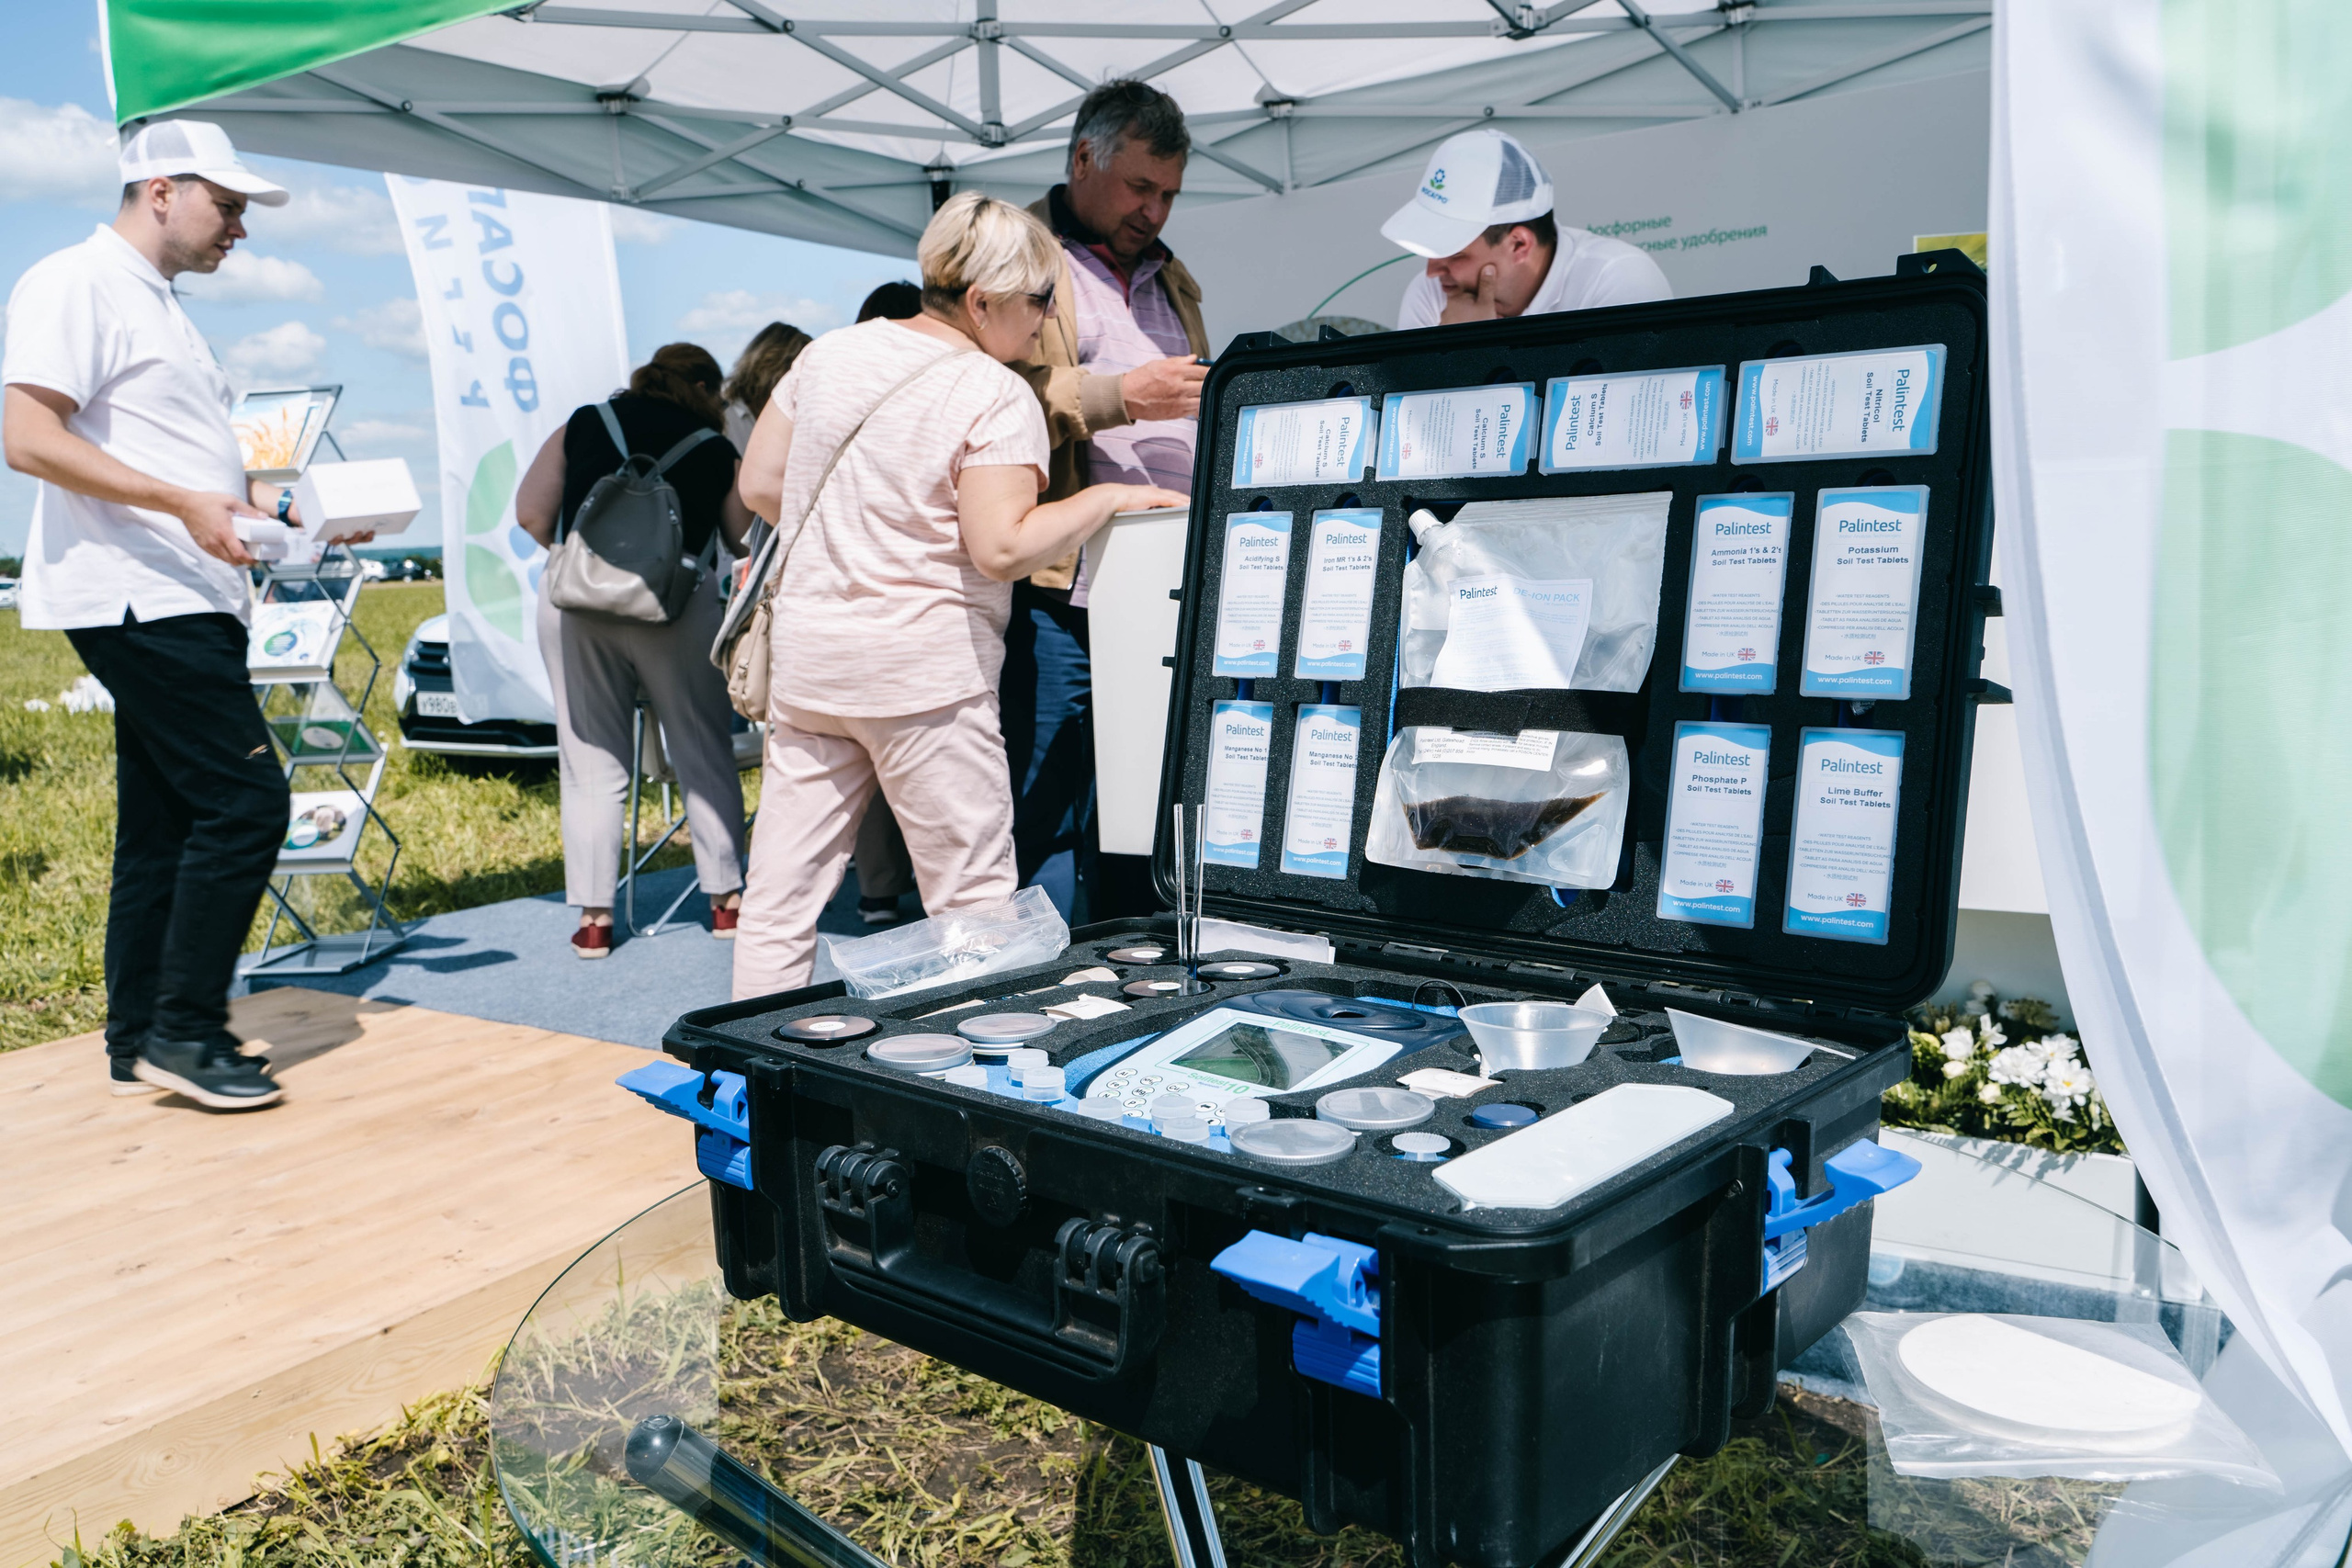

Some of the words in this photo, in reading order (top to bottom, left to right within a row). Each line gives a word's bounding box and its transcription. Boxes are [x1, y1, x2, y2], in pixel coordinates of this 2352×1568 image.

[1680, 225, 1768, 252] удобрения
[1865, 372, 1873, 388] Soil
[1599, 383, 1608, 409] Tablets
[1863, 391, 1871, 409] Test
[1892, 368, 1910, 432] Palintest
[1745, 375, 1758, 446] www.palintest.com
[1770, 404, 1776, 413] UK
[1872, 389, 1883, 422] Nitricol
[1565, 394, 1580, 450] Palintest
[1587, 401, 1597, 435] Calcium
[1681, 412, 1688, 421] UK
[1699, 380, 1713, 449] www.palintest.com
[1479, 417, 1488, 450] Calcium
[1496, 404, 1511, 457] Palintest
[1860, 412, 1870, 442] Tablets
[1322, 428, 1330, 459] Calcium
[1336, 416, 1350, 467] Palintest
[1386, 406, 1397, 468] www.palintest.com
[1240, 419, 1252, 476] www.palintest.com
[1470, 443, 1478, 468] Tablets
[1714, 521, 1772, 536] Palintest
[1838, 517, 1902, 533] Palintest
[1239, 536, 1278, 547] Palintest
[1326, 533, 1367, 544] Palintest
[1711, 547, 1747, 556] Ammonia
[1848, 546, 1898, 554] Potassium
[1460, 585, 1498, 600] Palintest
[1513, 587, 1551, 602] DE-ION
[1553, 593, 1580, 603] PACK
[1694, 671, 1762, 681] www.palintest.com
[1817, 676, 1892, 685] www.palintest.com
[1226, 723, 1264, 736] Palintest
[1310, 728, 1352, 741] Palintest
[1308, 750, 1342, 759] Manganese
[1693, 750, 1750, 765] Palintest
[1821, 758, 1883, 774] Palintest
[1691, 774, 1737, 784] Phosphate
[1827, 786, 1850, 795] Lime
[1853, 788, 1883, 796] Buffer
[1860, 799, 1891, 808] Tablets
[1293, 854, 1341, 867] www.palintest.com
[1672, 899, 1740, 913] www.palintest.com
[1801, 914, 1873, 929] www.palintest.com
[1272, 1021, 1331, 1038] Palintest
